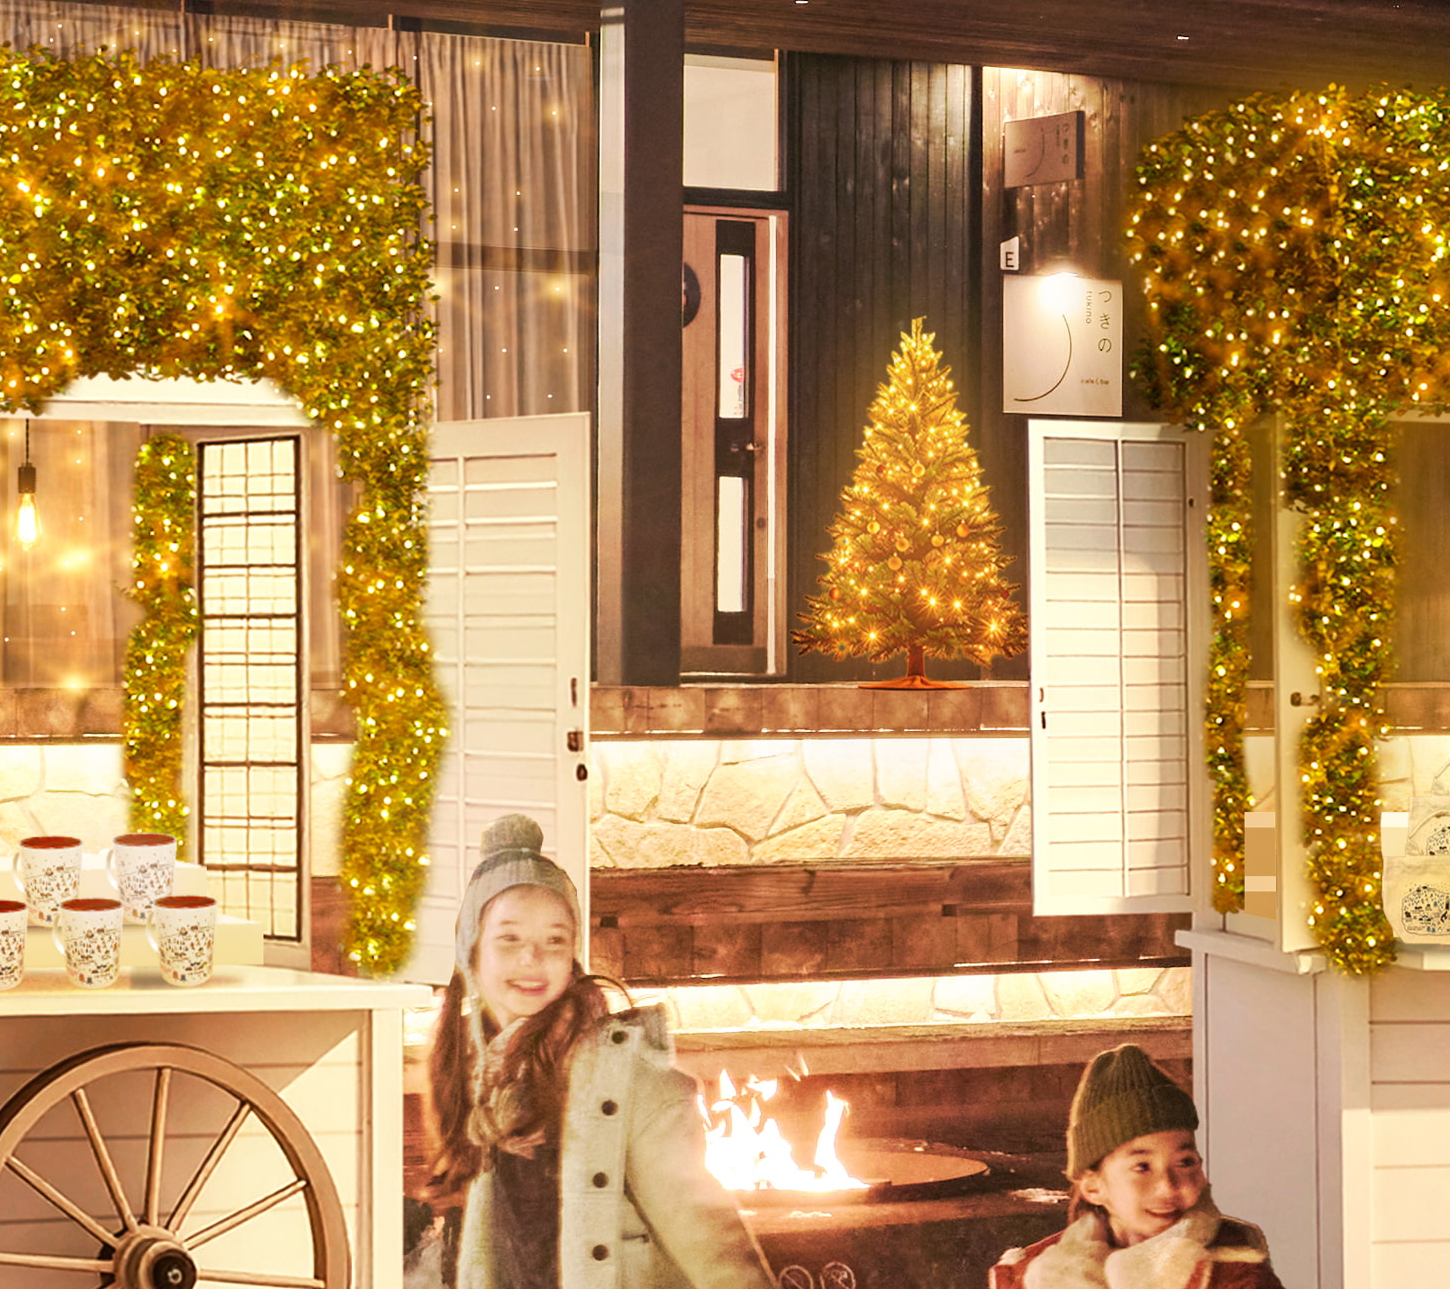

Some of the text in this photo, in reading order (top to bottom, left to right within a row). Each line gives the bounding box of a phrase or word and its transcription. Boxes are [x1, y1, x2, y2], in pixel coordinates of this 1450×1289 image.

[1005, 252, 1015, 268] E
[1098, 290, 1112, 353] つきの
